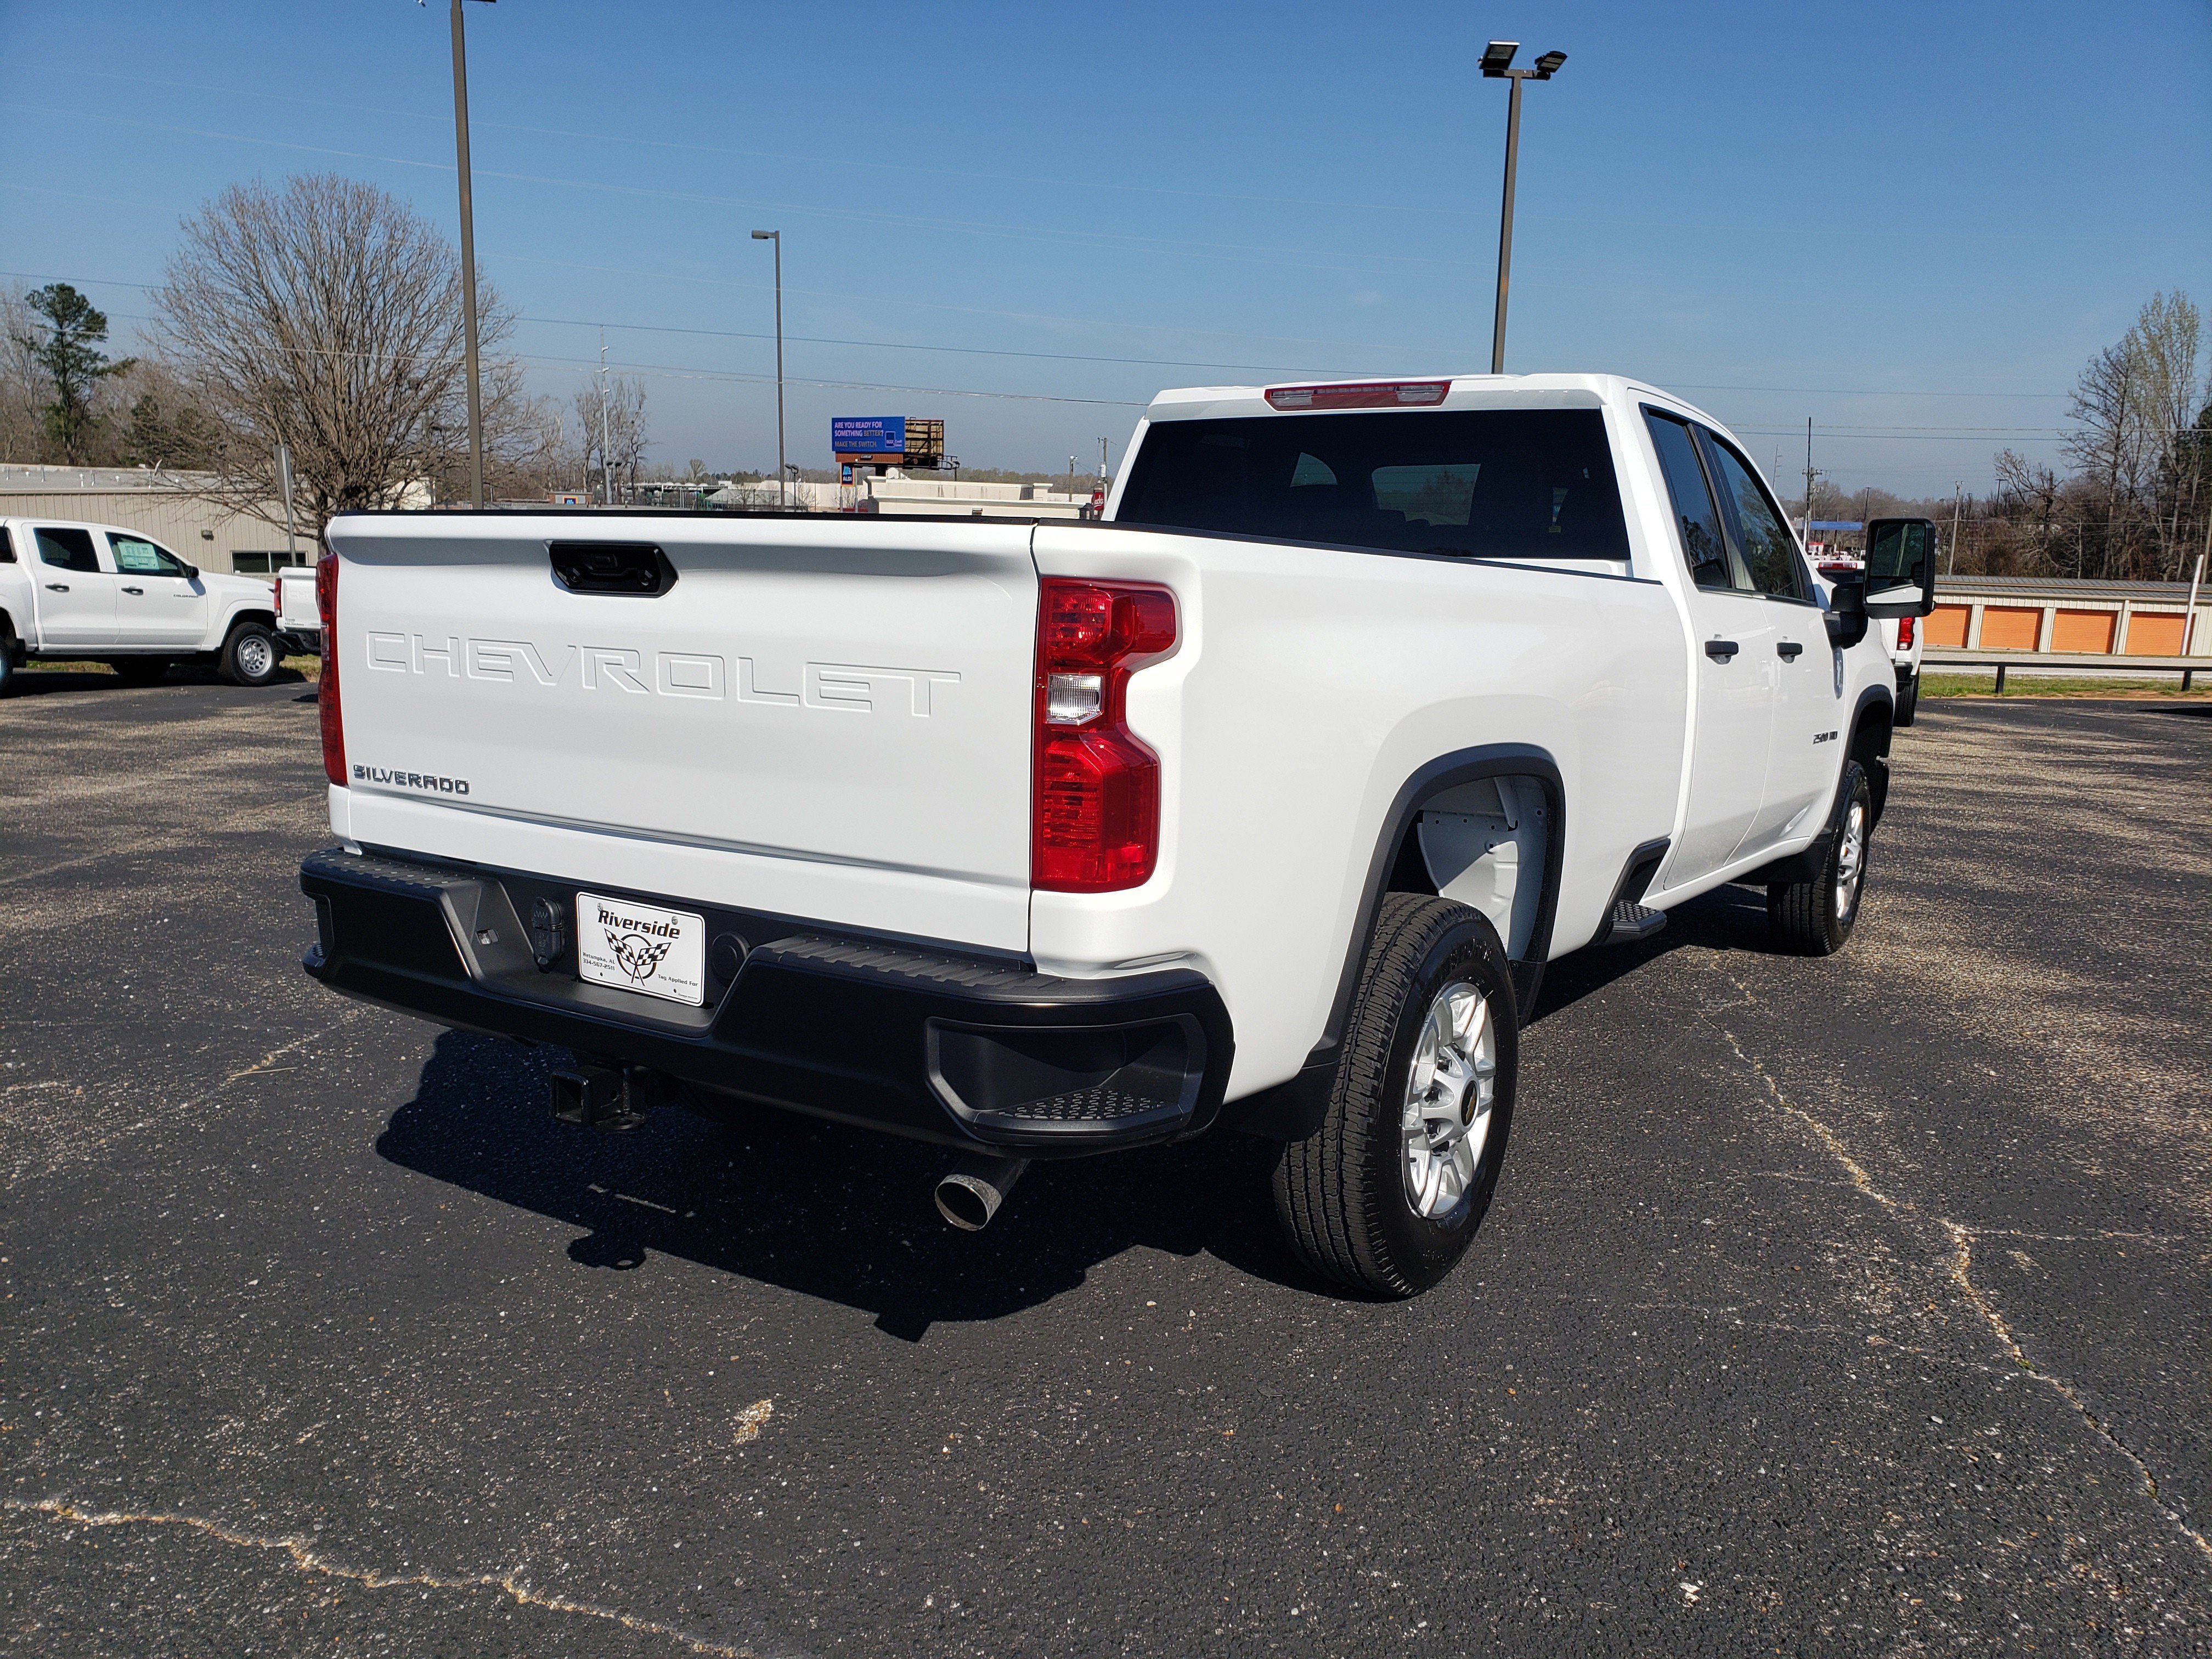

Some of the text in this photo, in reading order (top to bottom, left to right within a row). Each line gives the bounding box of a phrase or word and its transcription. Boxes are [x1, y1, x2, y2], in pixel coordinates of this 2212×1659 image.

[366, 631, 961, 718] CHEVROLET
[353, 764, 470, 794] SILVERADO
[598, 910, 680, 939] Riverside
[583, 952, 607, 963] Wetumpka,
[668, 977, 687, 985] Applied
